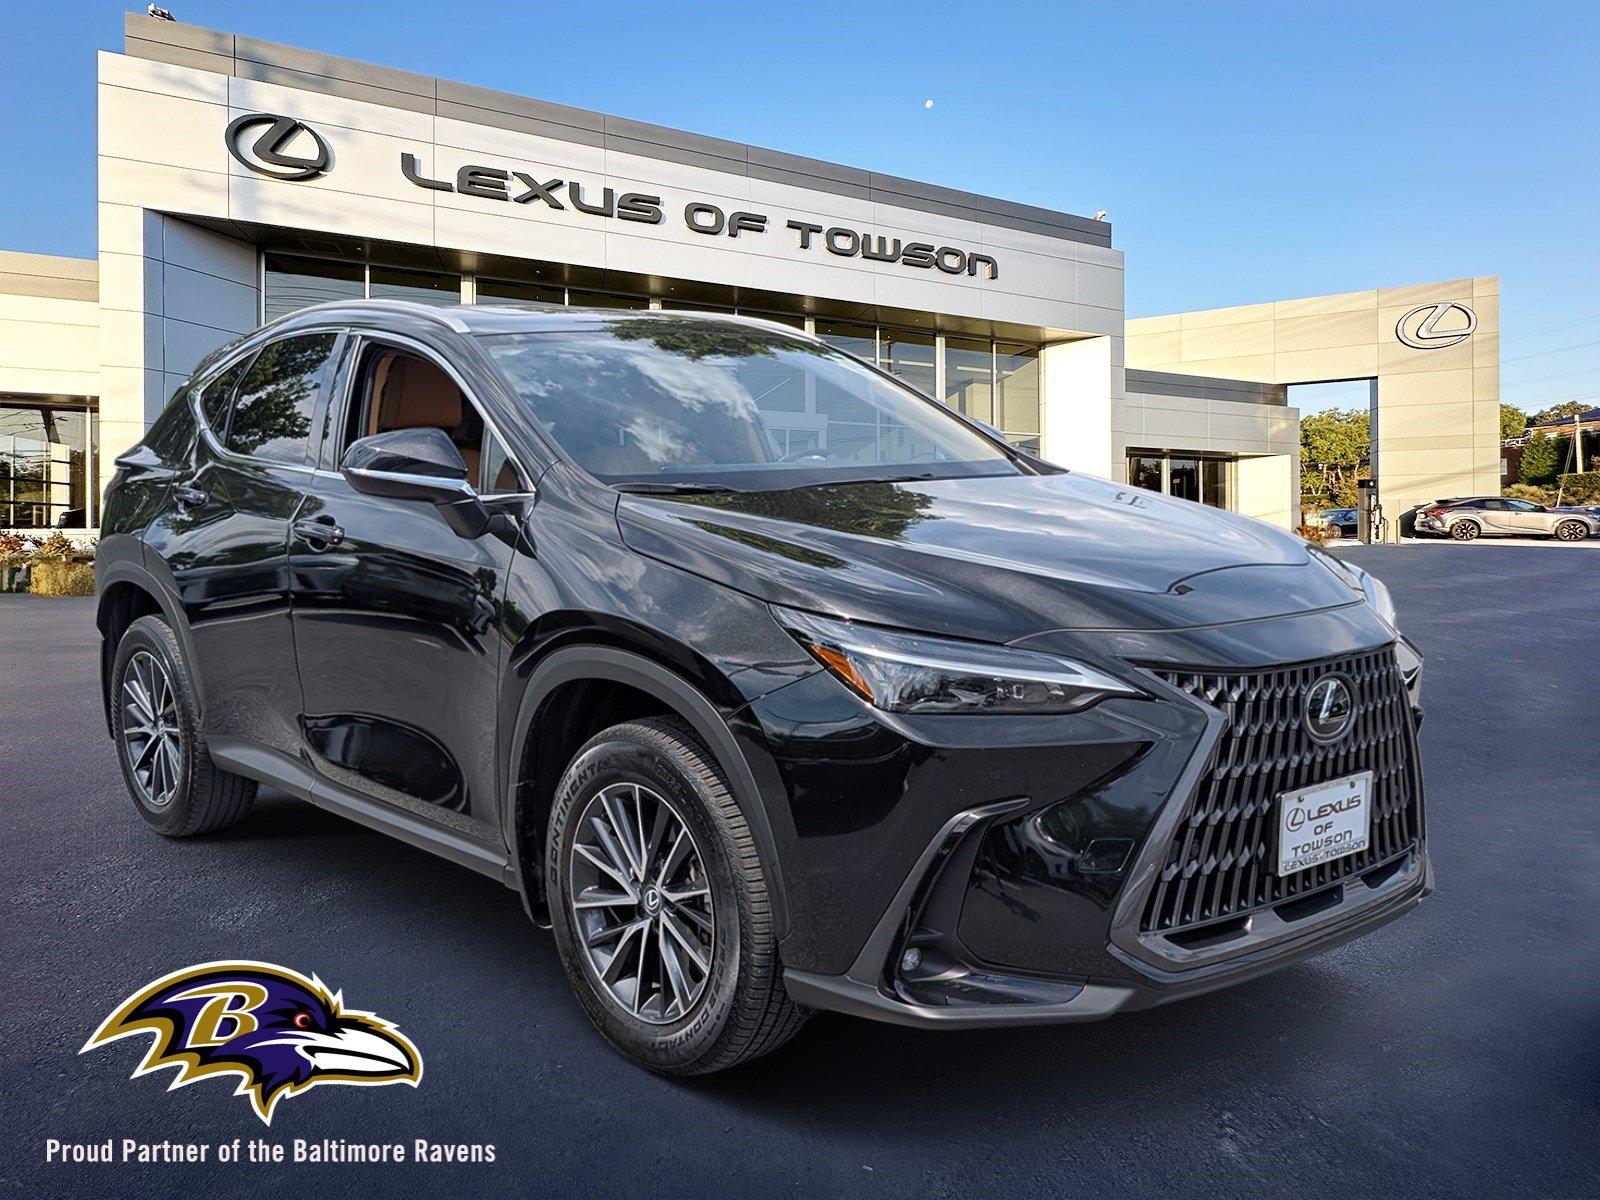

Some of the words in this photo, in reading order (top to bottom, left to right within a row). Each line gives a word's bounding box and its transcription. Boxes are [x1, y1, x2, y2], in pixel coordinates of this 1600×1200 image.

[401, 152, 662, 225] LEXUS
[684, 202, 767, 238] OF
[787, 219, 999, 280] TOWSON
[1307, 794, 1362, 821] LEXUS
[1314, 821, 1334, 836] OF
[1284, 854, 1318, 872] LEXUS
[1325, 840, 1366, 859] TOWSON
[1291, 829, 1353, 858] TOWSON
